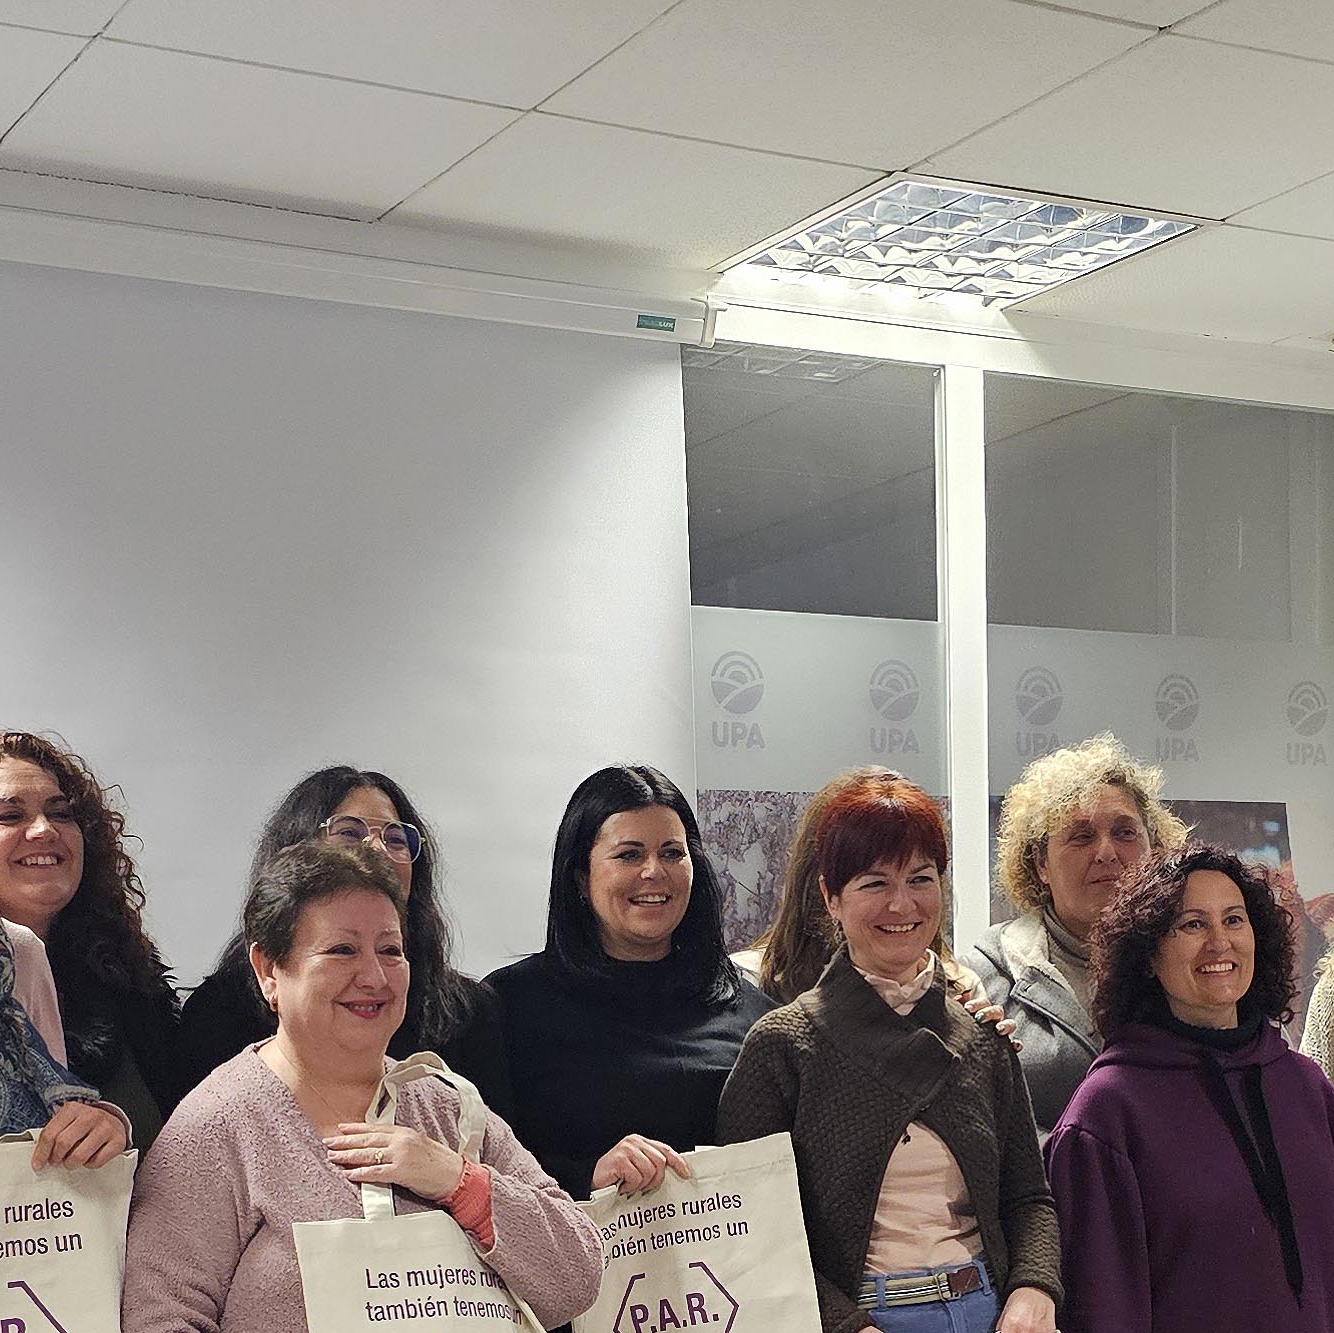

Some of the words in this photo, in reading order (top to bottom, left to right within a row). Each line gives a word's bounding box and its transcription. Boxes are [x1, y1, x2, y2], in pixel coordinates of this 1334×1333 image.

[712, 721, 765, 749] UPA
[870, 728, 919, 753] UPA
[1286, 742, 1329, 767] UPA
[4, 1198, 75, 1225] rurales
[682, 1193, 742, 1216] rurales
[55, 1231, 82, 1252] un
[650, 1223, 721, 1251] tenemos
[727, 1220, 749, 1237] un
[365, 1268, 400, 1289] Las
[406, 1264, 476, 1292] mujeres
[365, 1297, 449, 1322] también
[453, 1296, 511, 1321] tenemos
